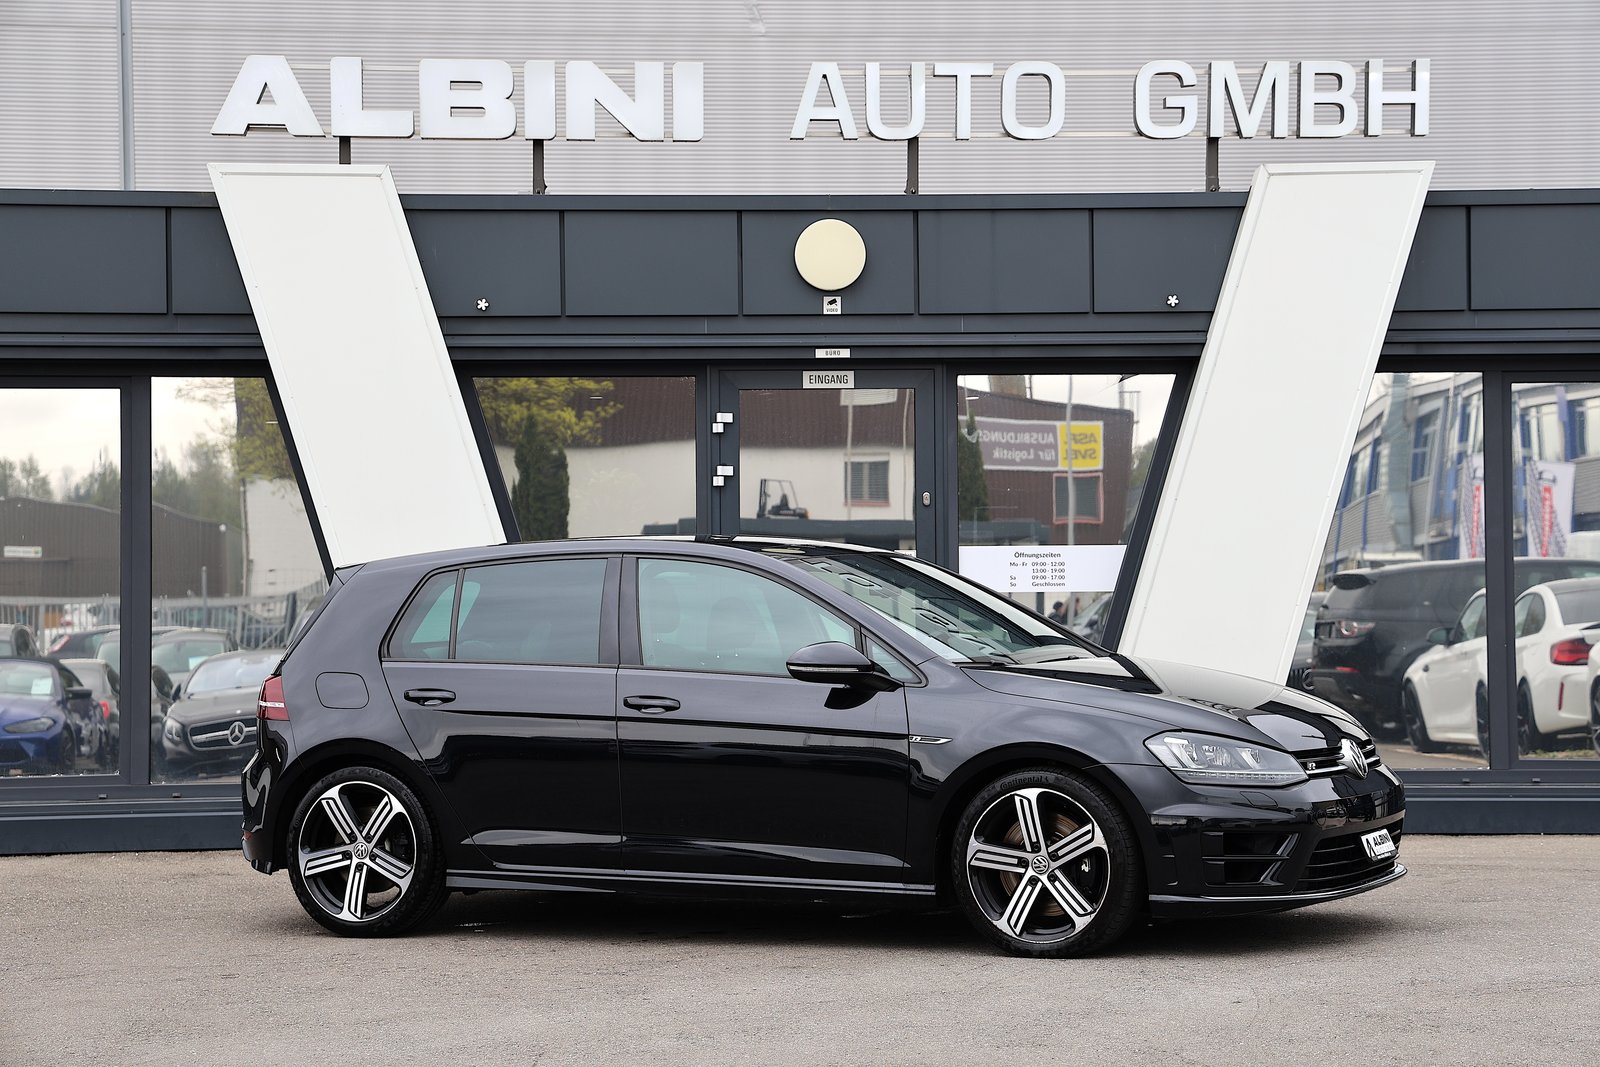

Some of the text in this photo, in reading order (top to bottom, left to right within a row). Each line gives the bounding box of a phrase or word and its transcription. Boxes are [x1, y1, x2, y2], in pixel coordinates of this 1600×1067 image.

[210, 54, 1432, 142] ALBINI AUTO GMBH
[808, 374, 849, 384] EINGANG
[1000, 775, 1043, 790] Continental
